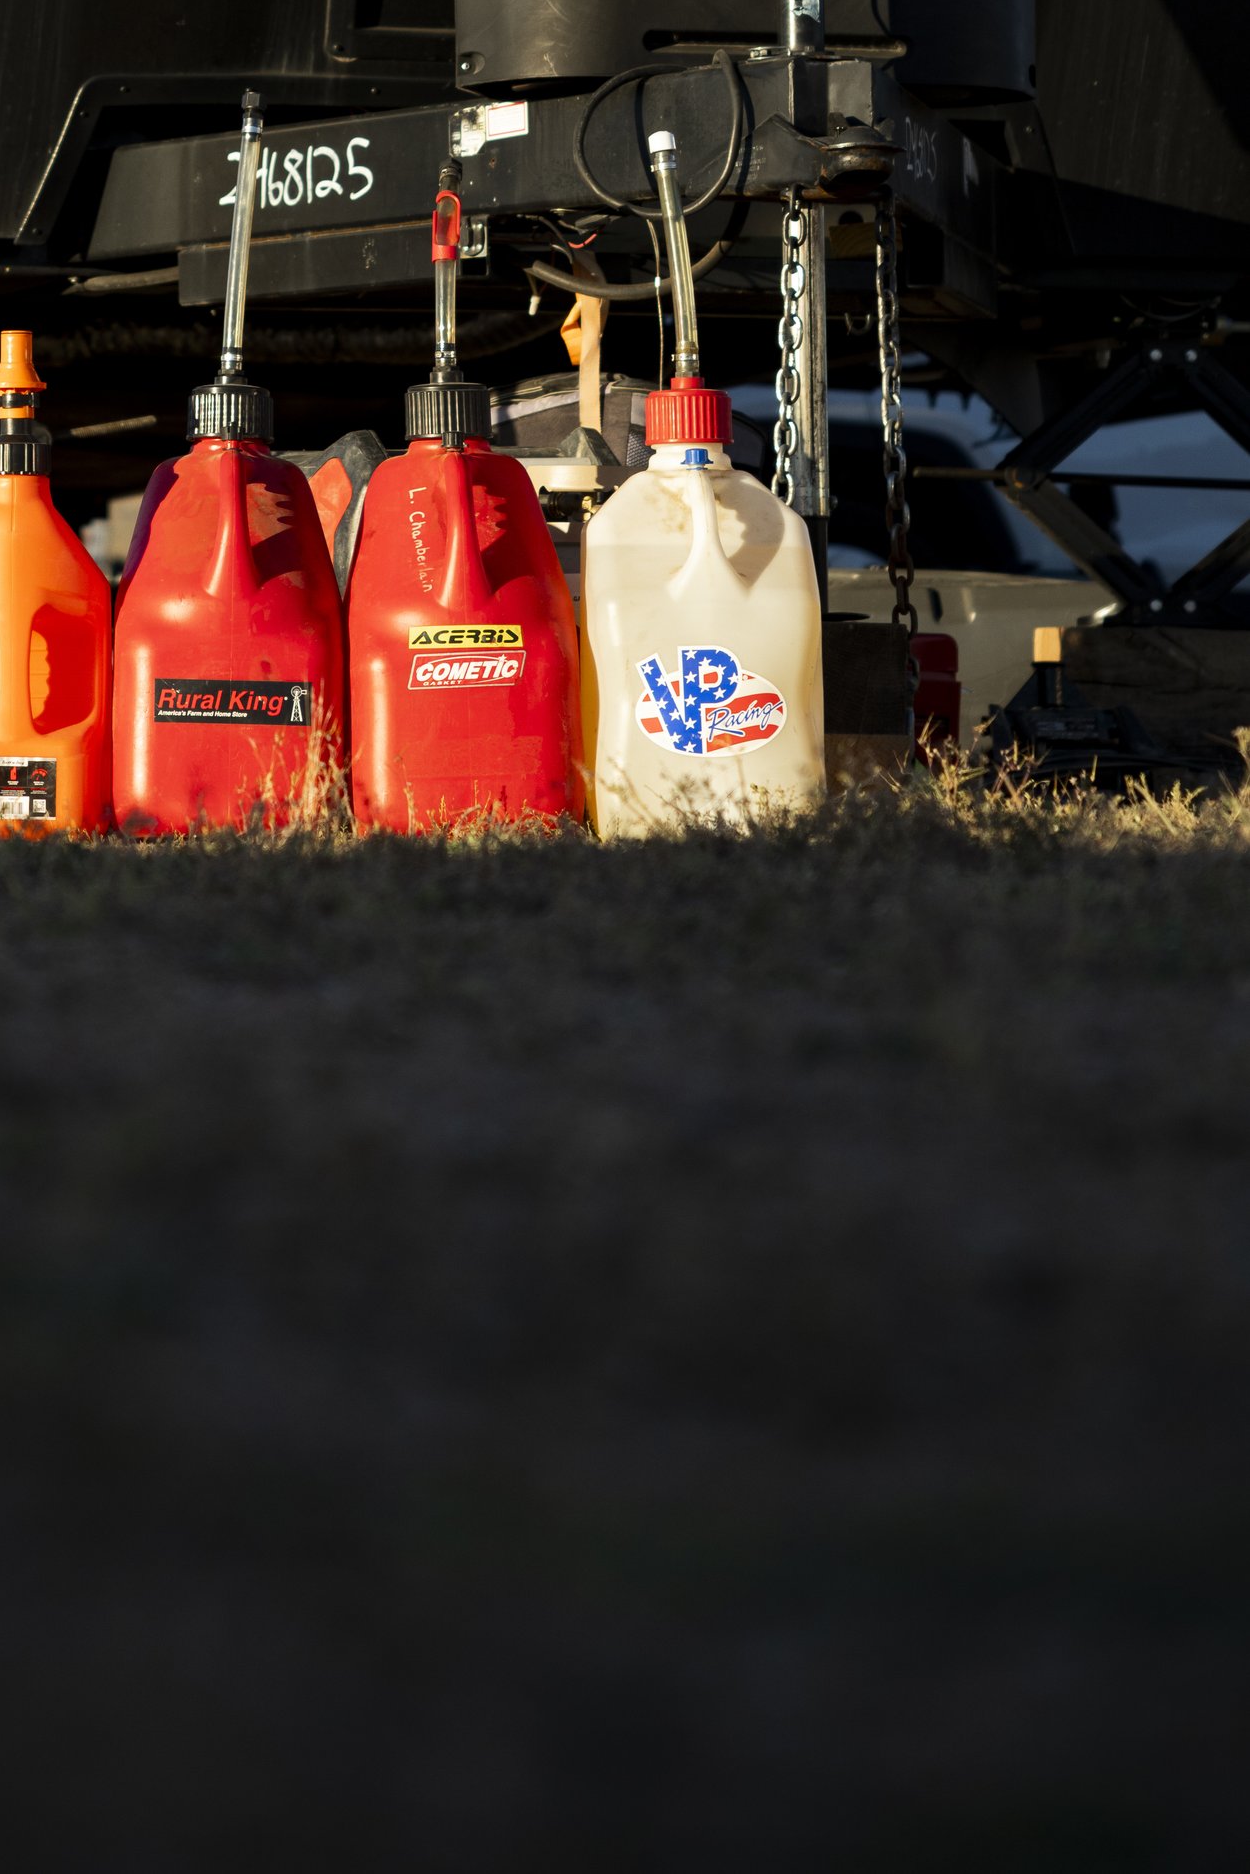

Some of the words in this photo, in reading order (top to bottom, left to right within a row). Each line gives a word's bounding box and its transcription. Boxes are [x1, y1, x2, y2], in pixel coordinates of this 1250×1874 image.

[408, 511, 435, 593] Chamberlain
[157, 688, 223, 710] Rural
[228, 690, 284, 717] King
[157, 709, 187, 717] America's
[214, 710, 232, 718] Home
[640, 649, 739, 755] VP
[708, 700, 784, 741] Racing
